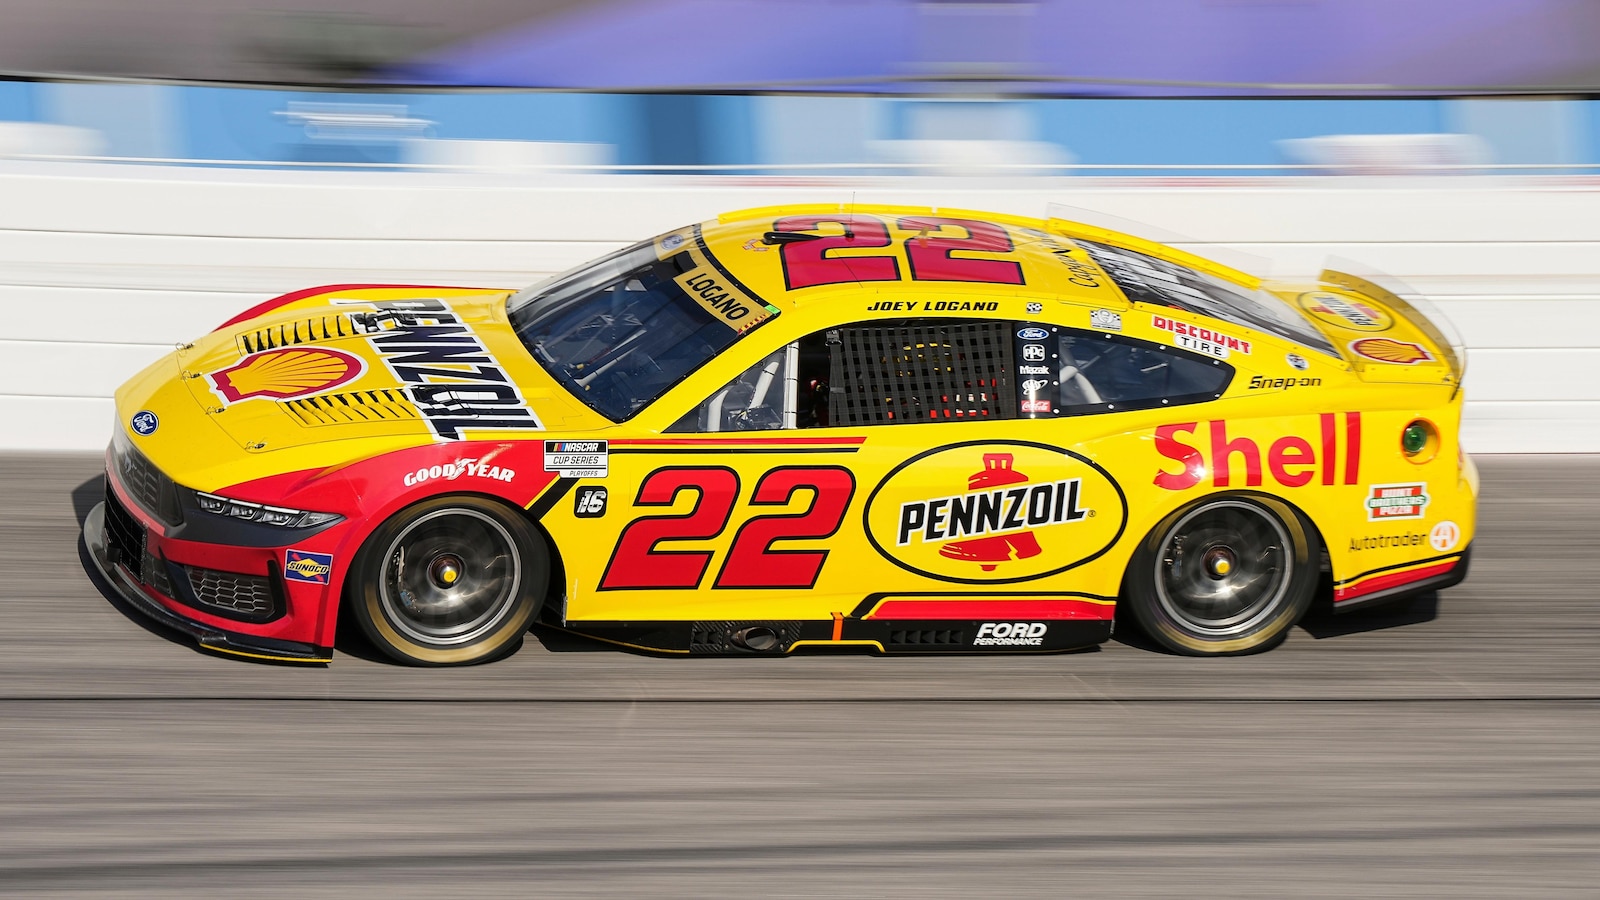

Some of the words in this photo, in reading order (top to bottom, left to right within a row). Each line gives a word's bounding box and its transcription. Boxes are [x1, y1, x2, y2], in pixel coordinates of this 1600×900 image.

[772, 214, 1026, 291] 22
[685, 273, 750, 321] LOGANO
[867, 301, 918, 312] JOEY
[923, 301, 999, 312] LOGANO
[1022, 329, 1043, 338] Ford
[1153, 315, 1251, 354] DISCOUNT
[1024, 345, 1044, 359] PPG
[1181, 336, 1223, 356] TIRE
[1020, 366, 1050, 375] Mazak
[1248, 375, 1322, 390] Snap-on
[563, 443, 599, 452] NASCAR
[1152, 411, 1361, 491] Shell
[553, 456, 570, 465] CUP
[570, 456, 599, 465] SERIES
[577, 490, 607, 513] 16
[898, 479, 1086, 545] PENNZOIL
[595, 465, 857, 592] 22
[1348, 531, 1427, 552] Autotrader
[288, 561, 329, 574] SUNOCO
[976, 622, 1048, 638] FORD
[973, 638, 1044, 646] PERFORMANCE
